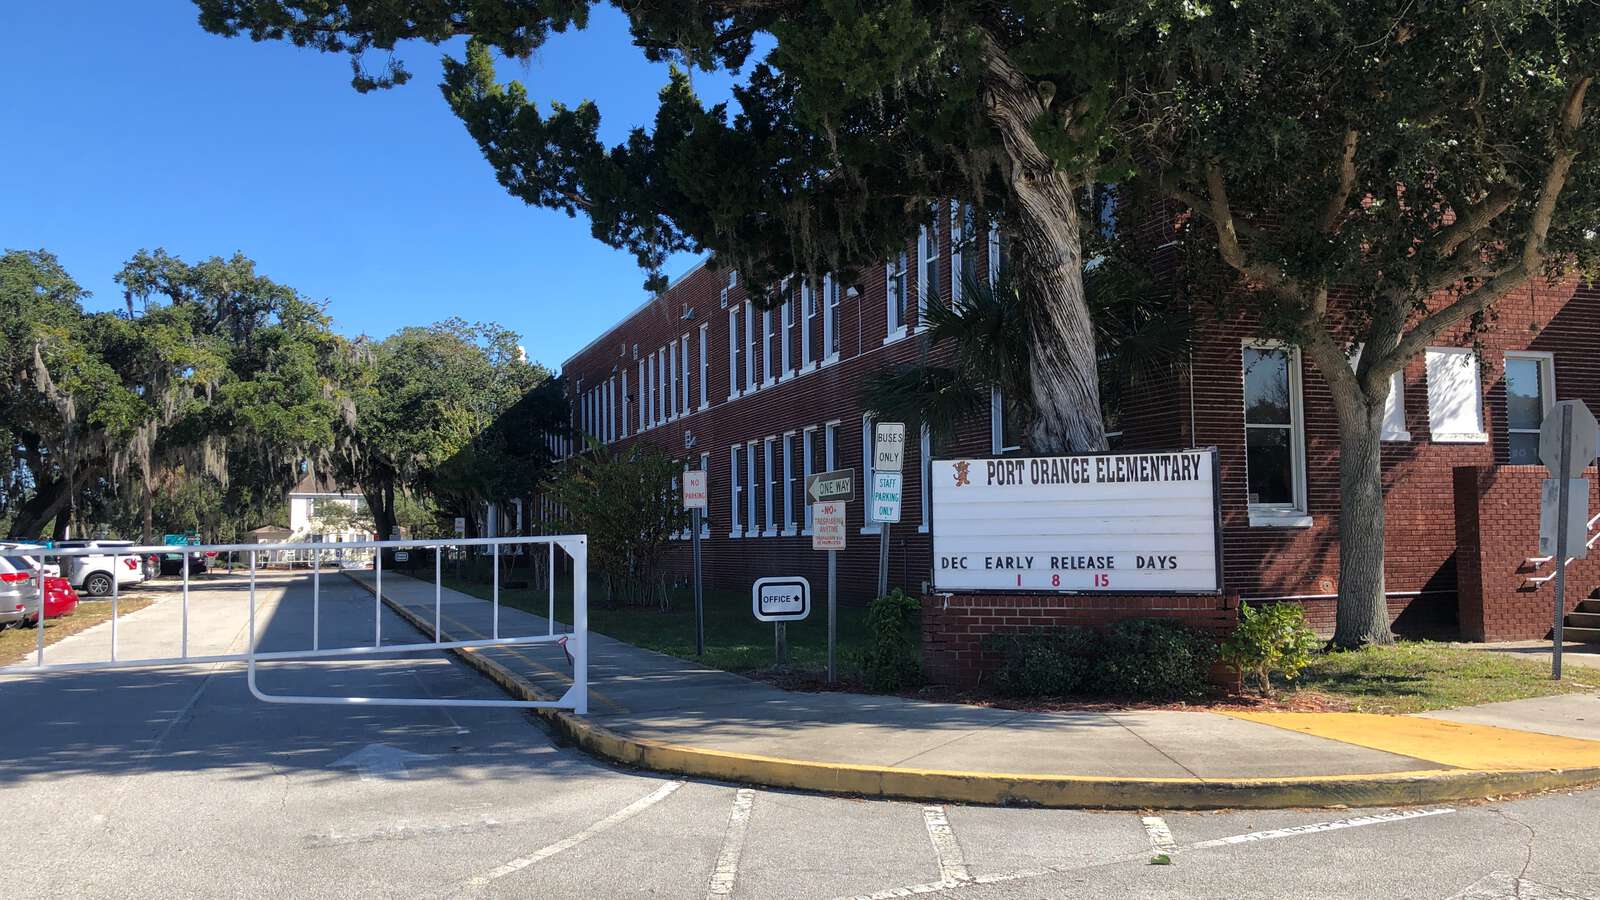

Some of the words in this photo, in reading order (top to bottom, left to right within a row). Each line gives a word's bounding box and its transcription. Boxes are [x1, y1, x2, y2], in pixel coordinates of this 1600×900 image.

[878, 432, 903, 443] BUSES
[879, 452, 899, 462] ONLY
[987, 459, 1025, 486] PORT
[1030, 457, 1090, 485] ORANGE
[1096, 454, 1201, 484] ELEMENTARY
[820, 482, 834, 495] ONE
[836, 479, 850, 493] WAY
[879, 478, 896, 488] STAFF
[875, 492, 899, 502] PARKING
[879, 506, 893, 516] ONLY
[941, 556, 968, 570] DEC
[985, 556, 1034, 570] EARLY
[1051, 556, 1115, 570] RELEASE
[1136, 555, 1178, 569] DAYS
[1016, 574, 1022, 587] 1
[1051, 574, 1061, 588] 8
[1094, 574, 1110, 587] 15
[763, 595, 791, 603] OFFICE
